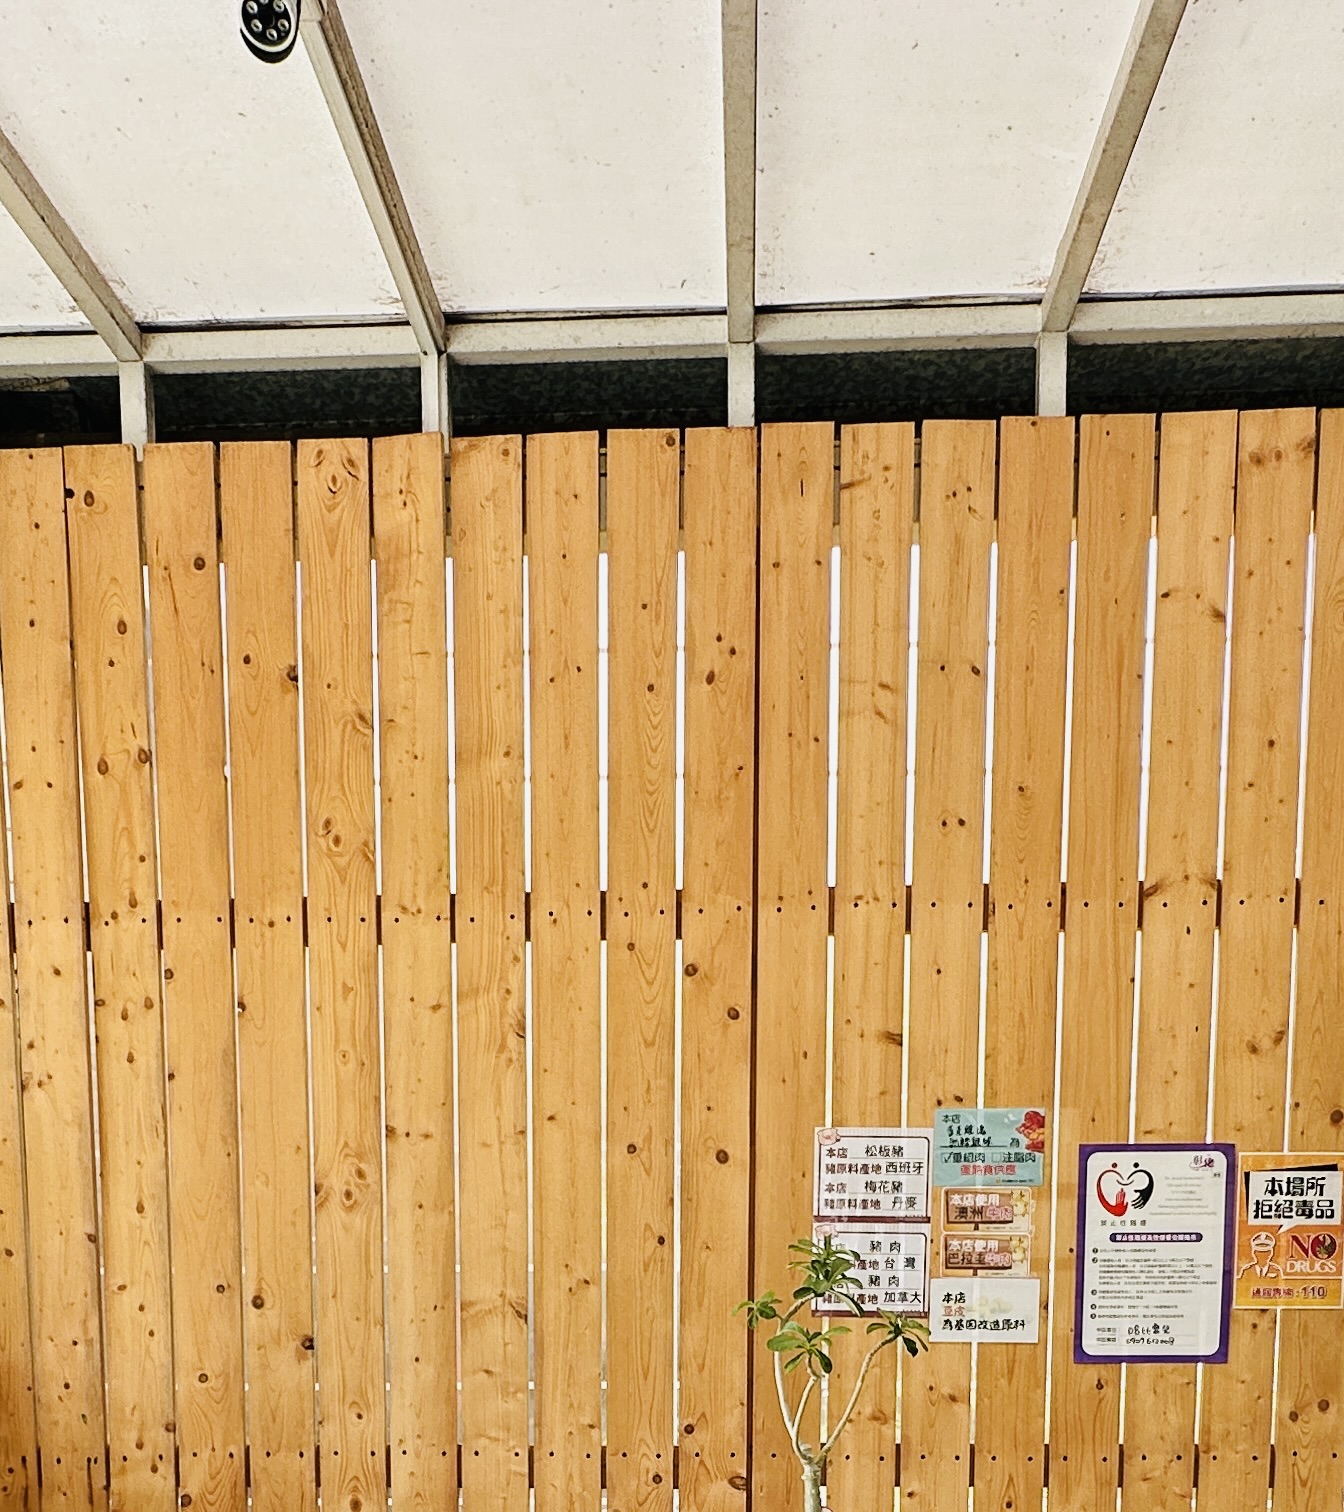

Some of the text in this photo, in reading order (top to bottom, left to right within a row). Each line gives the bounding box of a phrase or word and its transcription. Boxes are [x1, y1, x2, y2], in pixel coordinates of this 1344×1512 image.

[825, 1147, 848, 1158] 本店
[825, 1161, 924, 1174] 豬原料產地 西班牙
[824, 1180, 903, 1194] 本店 梅花豬
[1264, 1176, 1327, 1197] 本場所
[824, 1196, 918, 1210] 豬原料產地 丹麥
[949, 1193, 1001, 1208] 本店使用
[1253, 1199, 1335, 1220] 拒絕毒品
[869, 1240, 902, 1255] 豬肉
[948, 1239, 999, 1253] 本店使用
[1289, 1233, 1337, 1260] NO
[884, 1256, 917, 1270] 台灣
[1286, 1259, 1337, 1273] DRUGS
[867, 1274, 900, 1288] 豬肉
[883, 1291, 923, 1304] 加拿大
[942, 1291, 967, 1305] 本店
[1301, 1286, 1328, 1299] 110
[941, 1318, 1027, 1332] 為基因改造原料
